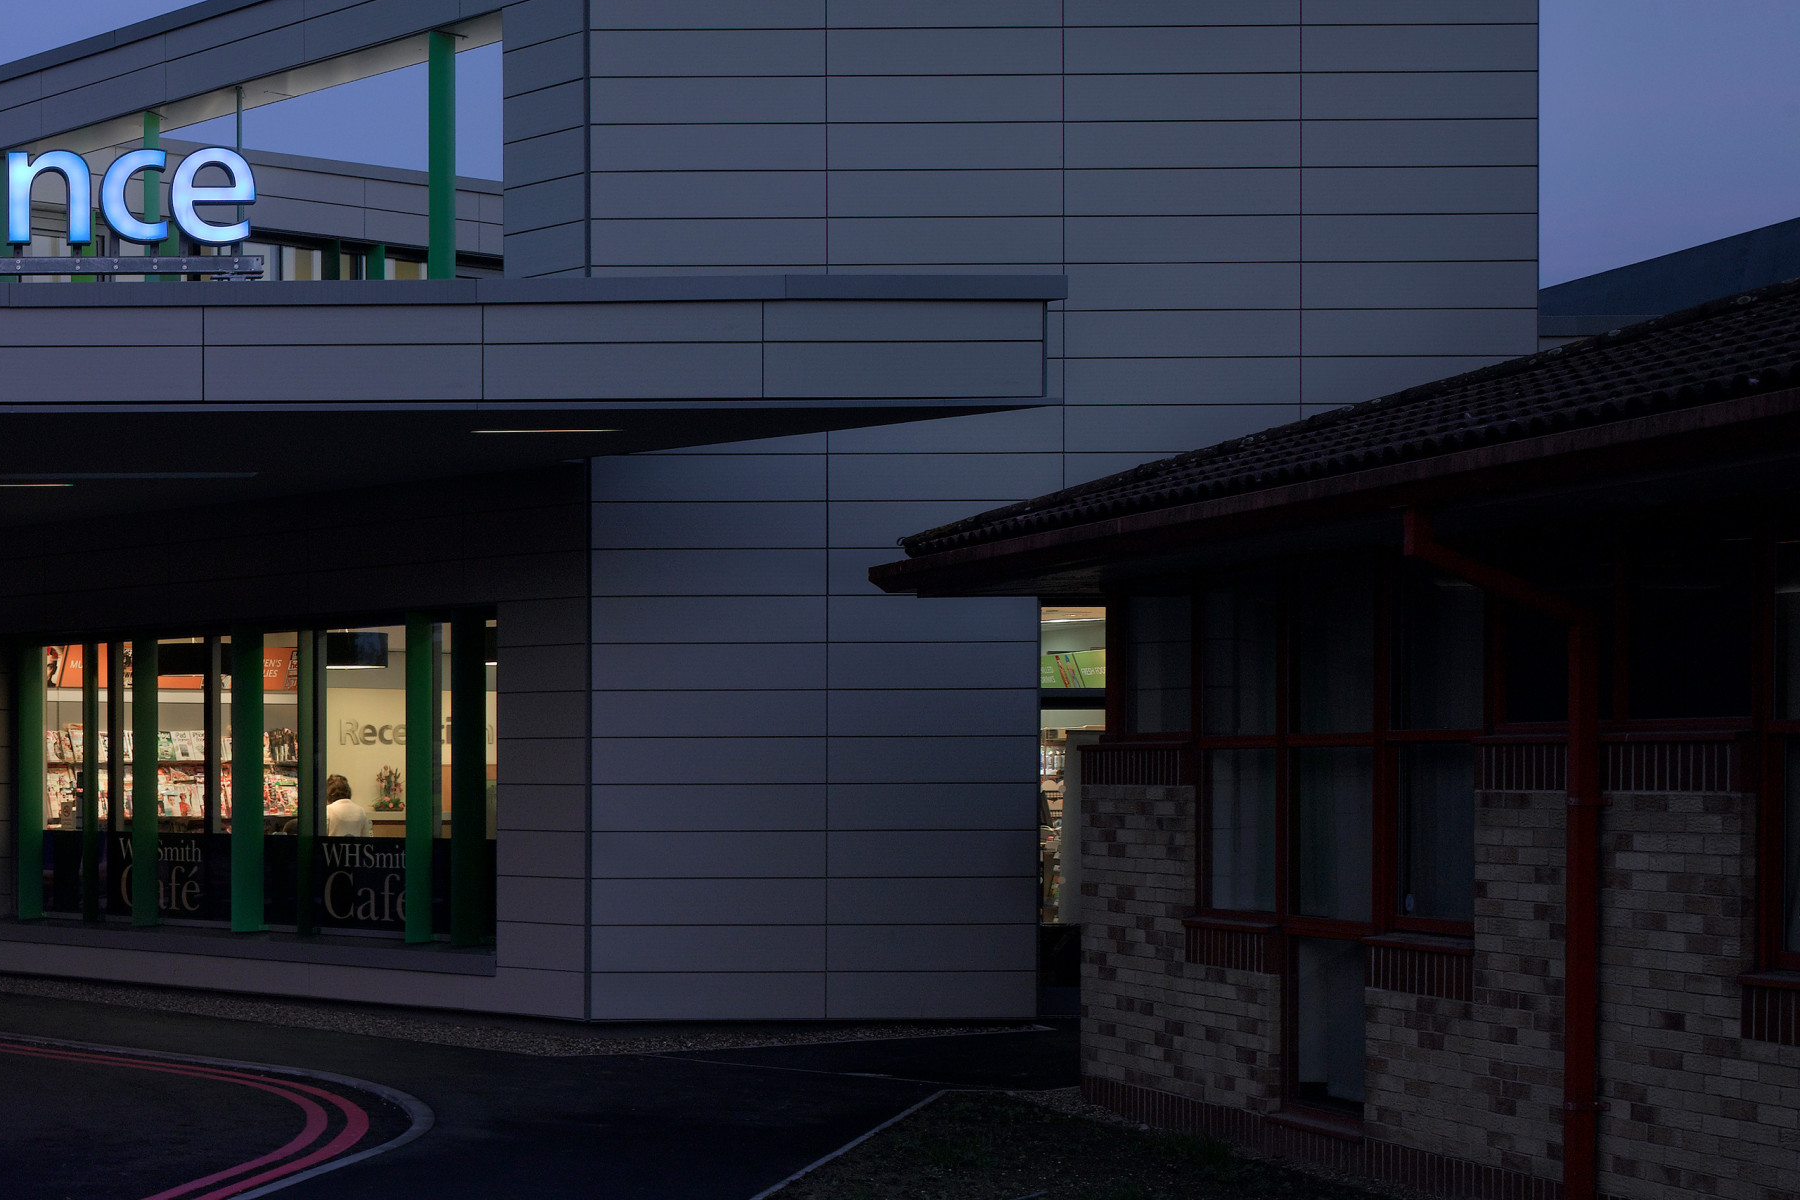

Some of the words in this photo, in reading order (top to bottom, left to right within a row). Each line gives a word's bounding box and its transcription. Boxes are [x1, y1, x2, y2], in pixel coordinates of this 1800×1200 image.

[263, 658, 283, 668] EN'S
[263, 668, 279, 678] LIES
[322, 842, 406, 869] WHSmit
